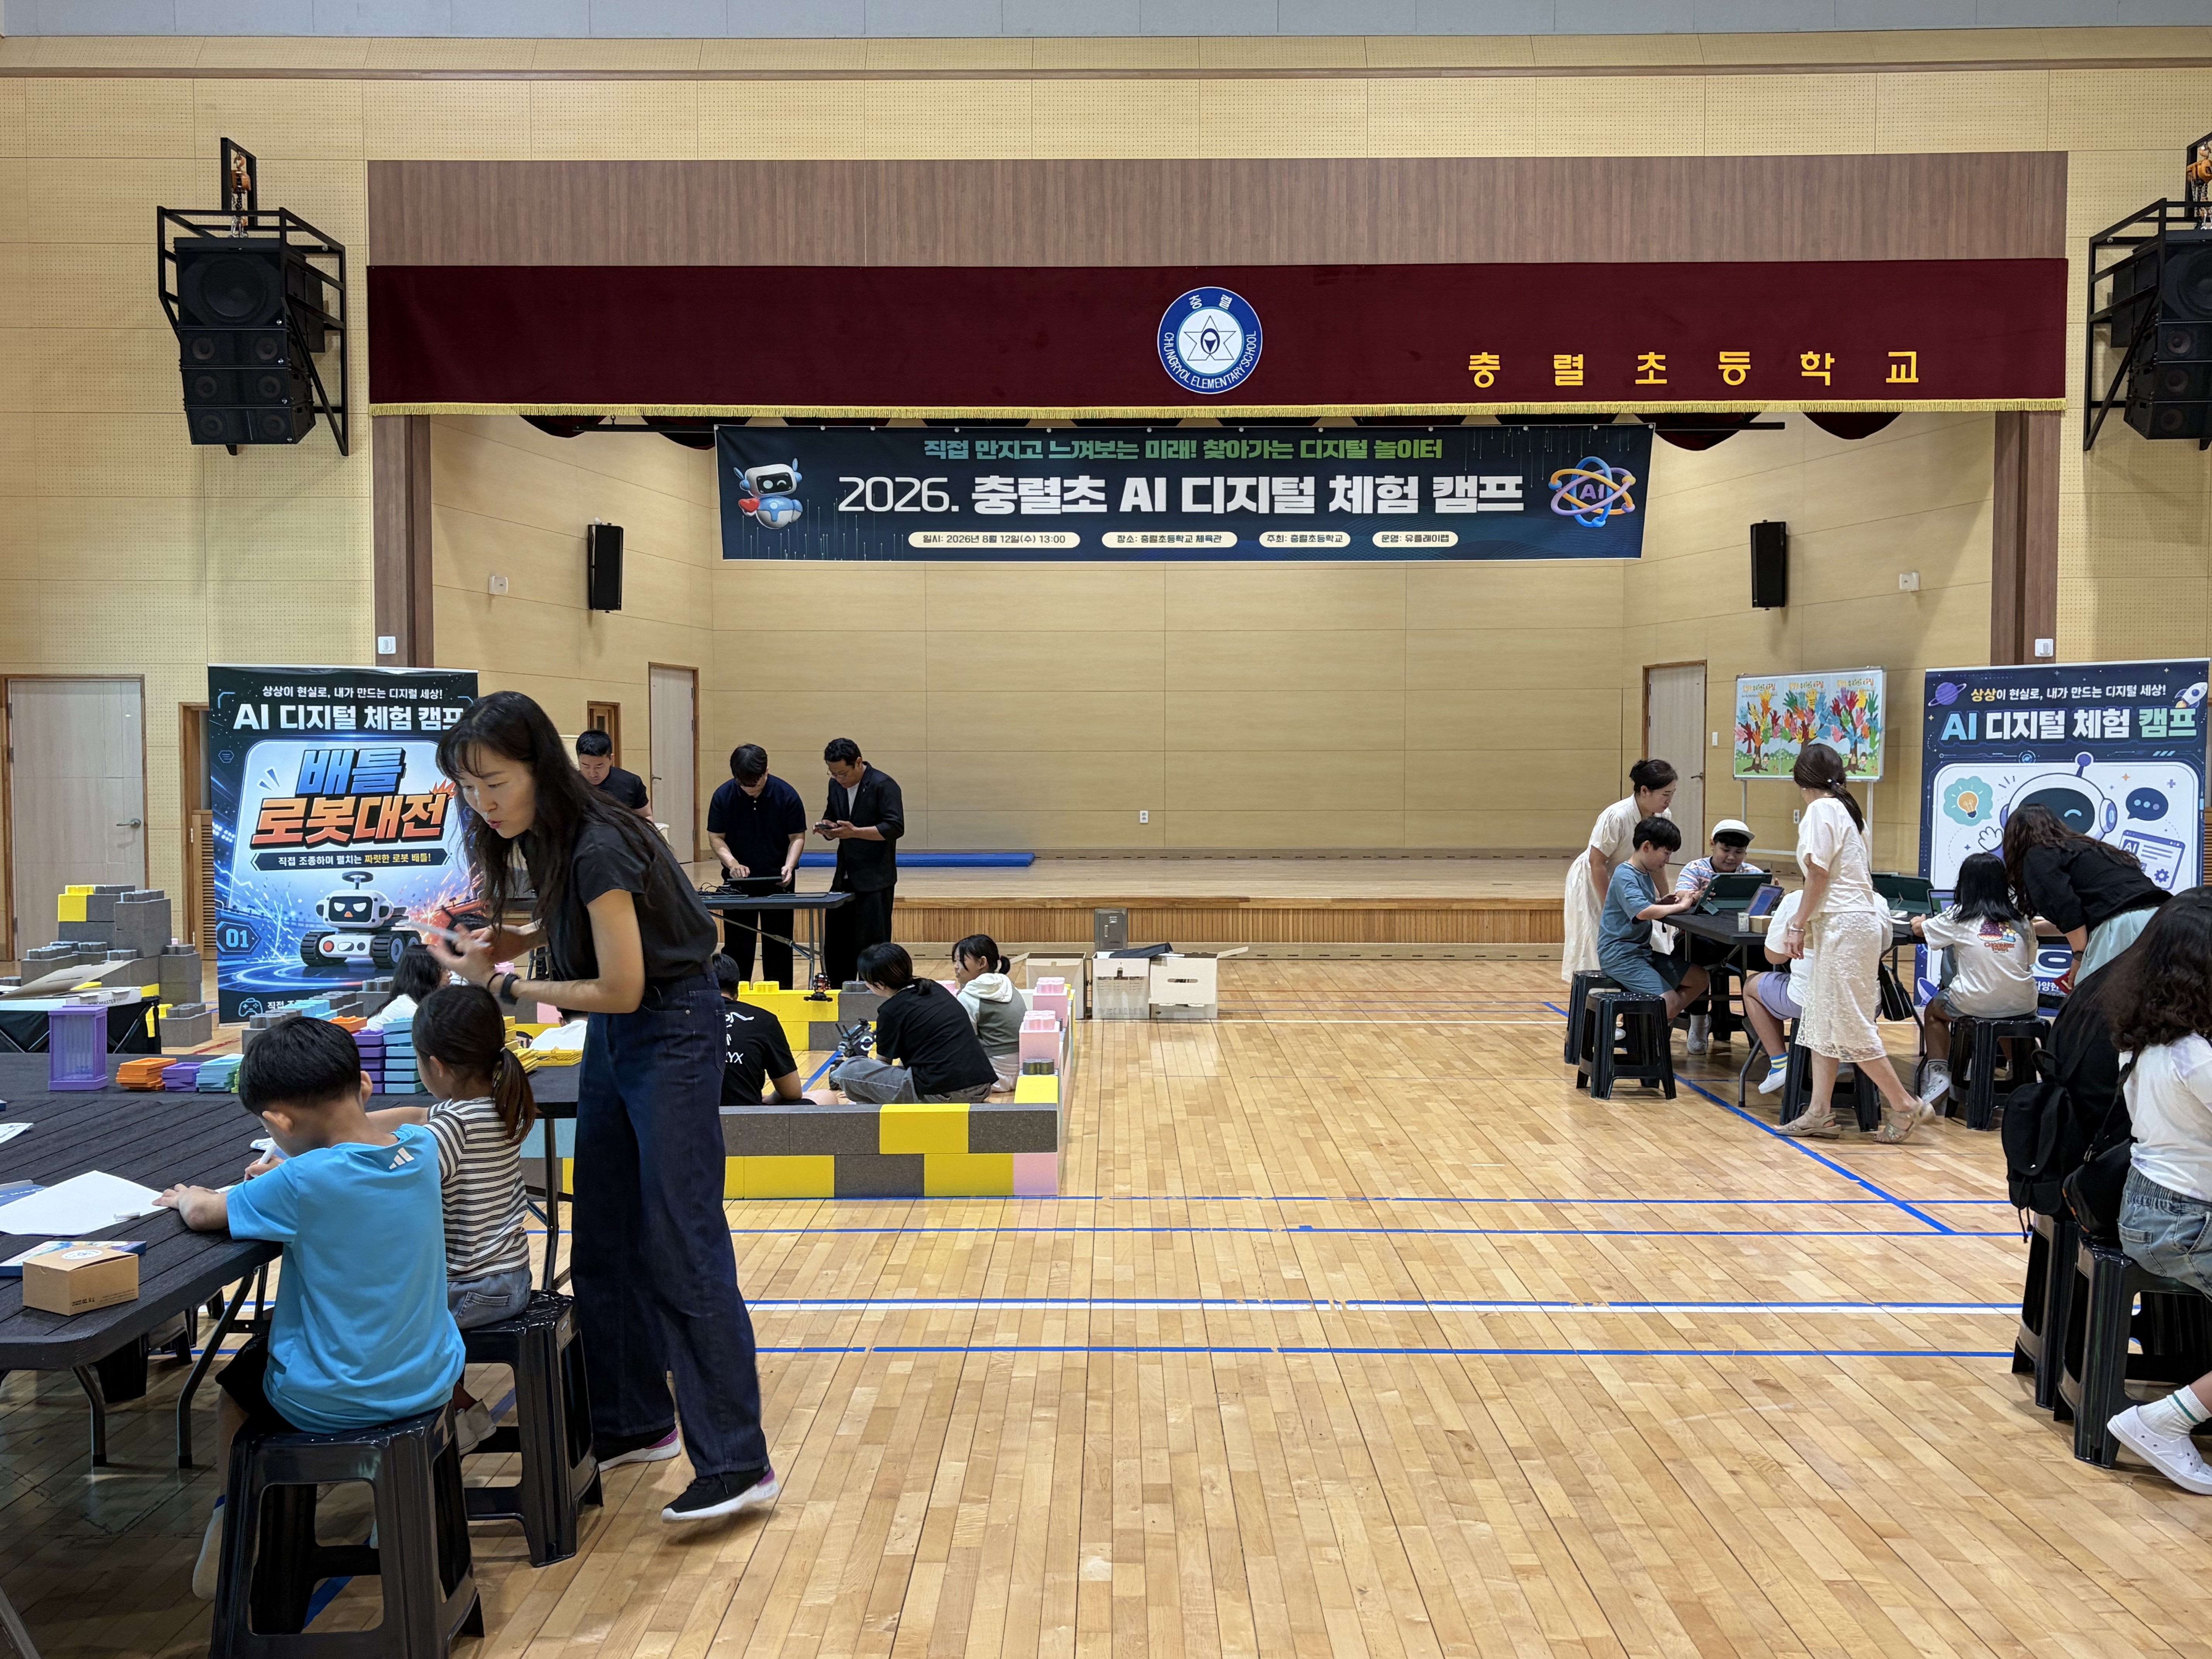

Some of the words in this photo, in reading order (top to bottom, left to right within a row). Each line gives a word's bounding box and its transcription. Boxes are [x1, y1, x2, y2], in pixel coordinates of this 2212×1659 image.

[1164, 332, 1190, 383] CHUNGRYOL
[1190, 366, 1245, 389] ELEMENTARY
[1241, 330, 1256, 367] SCHOOL
[924, 440, 969, 459] 직접
[975, 440, 1043, 460] 만지고
[1048, 440, 1139, 459] 느껴보는
[1145, 440, 1197, 459] 미래!
[1203, 439, 1294, 459] 찾아가는
[1300, 440, 1367, 459] 디지털
[1374, 439, 1442, 459] 놀이터
[838, 477, 959, 512] 2026.
[972, 475, 1108, 514] 충렬초
[1119, 477, 1166, 512] AI
[1182, 476, 1315, 514] 디지털
[1329, 475, 1419, 514] 체험
[1433, 476, 1524, 513] 캠프
[1580, 484, 1604, 499] AI
[923, 535, 943, 543] 일시:
[946, 535, 979, 543] 2026년
[982, 535, 997, 543] 8월
[1039, 535, 1065, 543] 13:00
[1117, 535, 1137, 543] 장소:
[1140, 534, 1193, 543] 충렬초등학교
[1195, 535, 1222, 543] 체육관
[1267, 534, 1287, 543] 주최:
[1290, 534, 1343, 543] 충렬초등학교
[1381, 534, 1402, 543] 운영:
[262, 686, 293, 697] 상상이
[297, 686, 330, 698] 현실로,
[334, 687, 354, 698] 내가
[357, 687, 386, 699] 만드는
[389, 688, 417, 699] 디지털
[420, 689, 442, 699] 세상!
[1971, 688, 2006, 702] 상상이
[2009, 688, 2043, 701] 현실로,
[2047, 687, 2068, 699] 내가
[2071, 686, 2102, 699] 만드는
[2106, 684, 2137, 697] 디지털
[2140, 684, 2166, 696] 세상!
[233, 704, 269, 730] AI
[280, 705, 356, 730] 디지털
[364, 706, 412, 730] 체험
[1941, 713, 1977, 740] AI
[1986, 710, 2065, 740] 디지털
[2072, 708, 2130, 738] 체험
[2138, 708, 2197, 738] 캠프
[297, 748, 404, 795] 배틀
[251, 795, 448, 844] 로봇대전
[278, 856, 295, 866] 직접
[299, 855, 333, 866] 조종하며
[336, 855, 362, 865] 펼치는
[364, 854, 390, 864] 짜릿한
[392, 854, 409, 863] 로봇
[411, 853, 431, 862] 배틀!
[226, 929, 249, 948] 01
